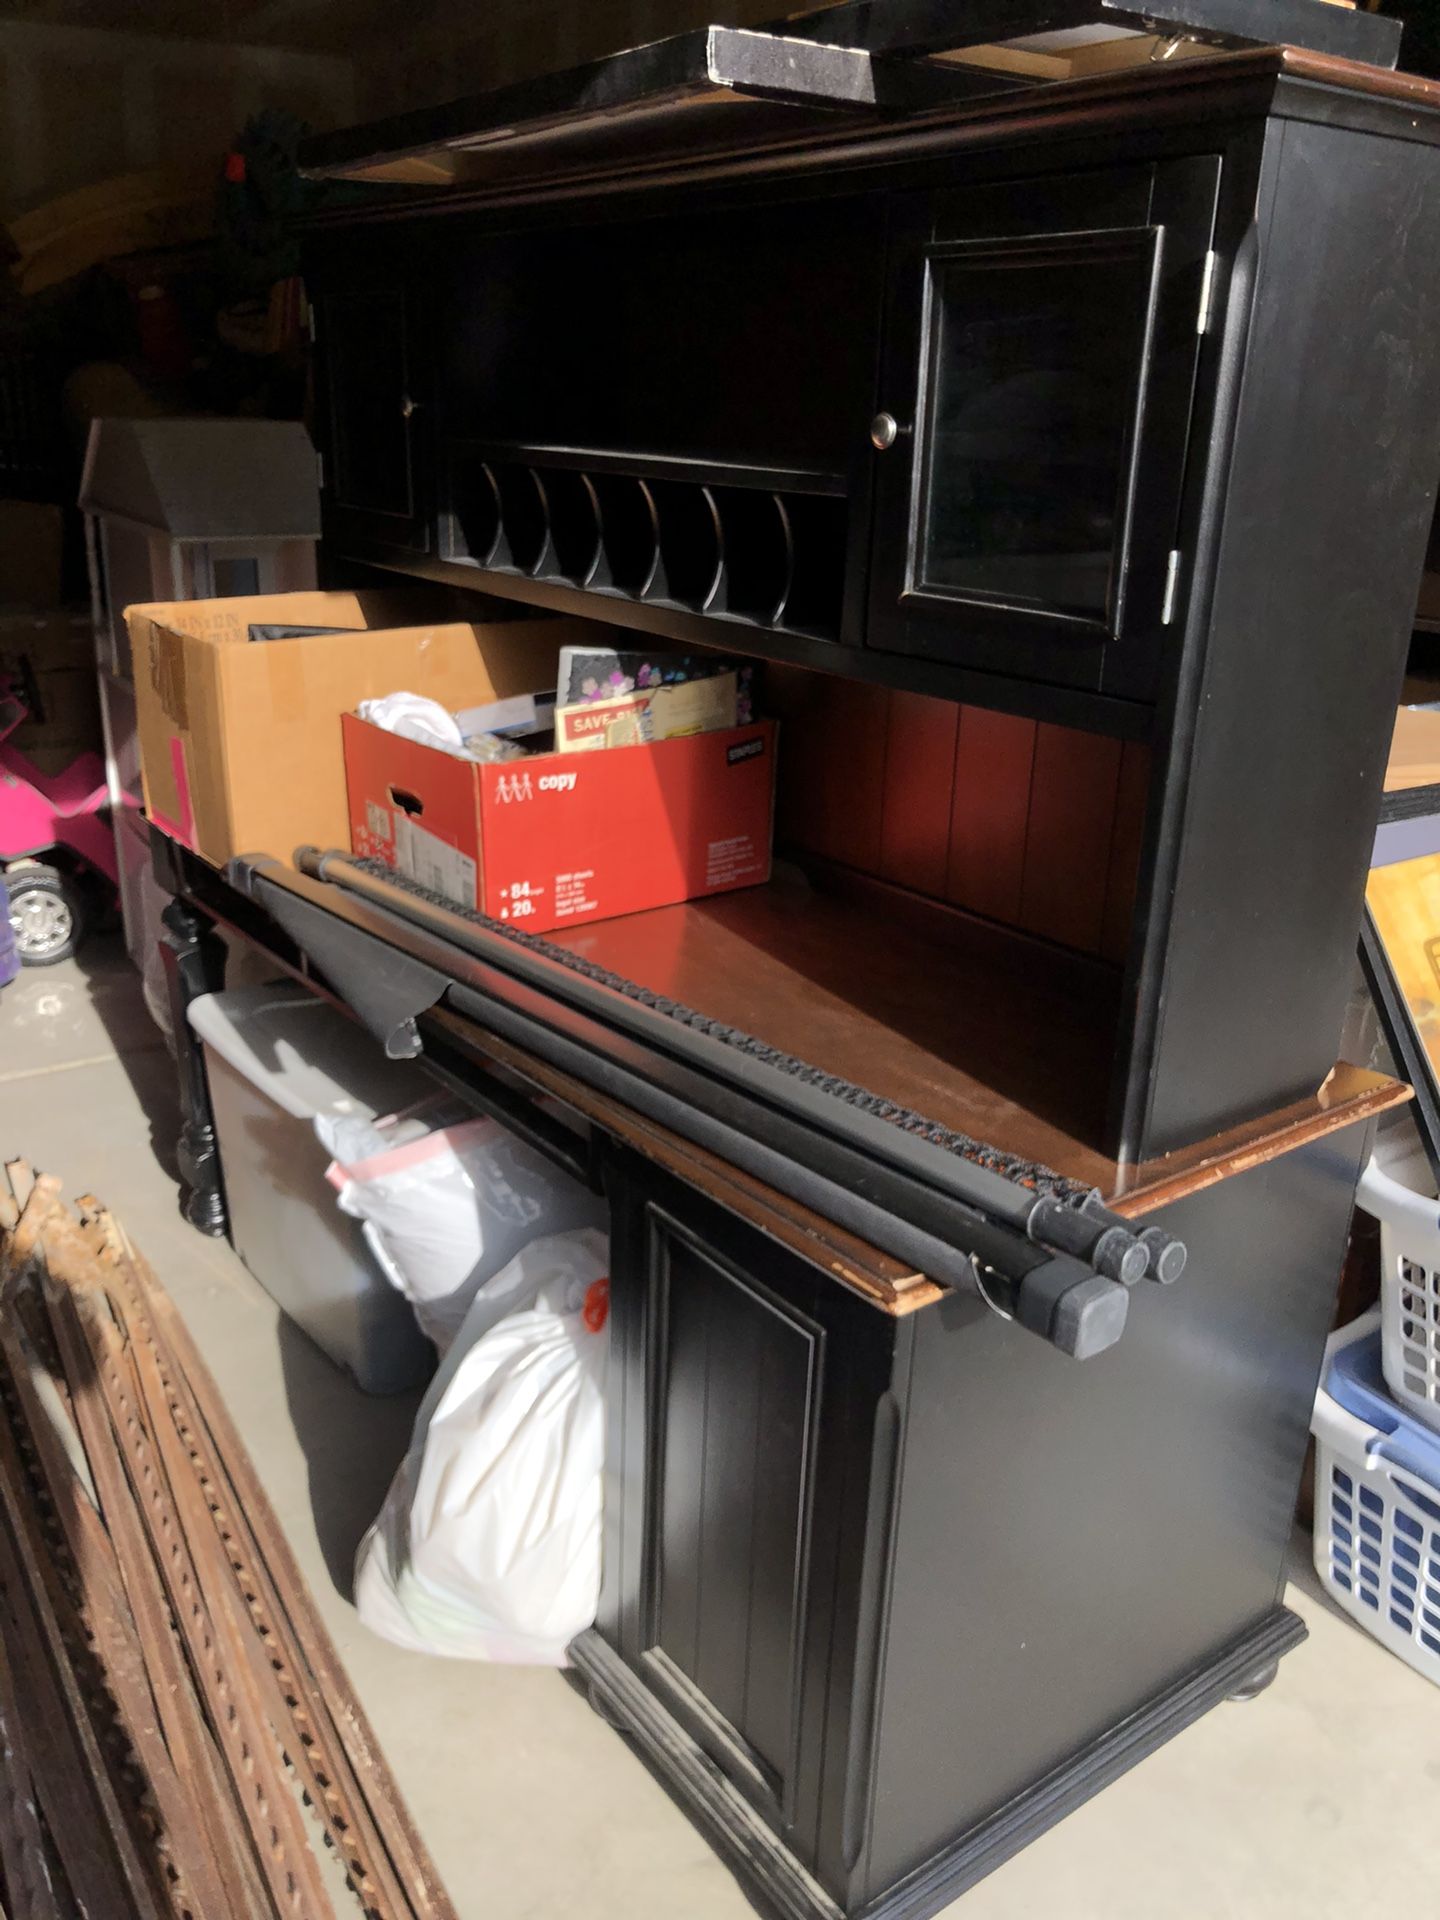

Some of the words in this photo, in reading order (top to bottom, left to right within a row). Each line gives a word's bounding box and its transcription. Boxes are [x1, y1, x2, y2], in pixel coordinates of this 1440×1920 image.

[573, 714, 611, 733] SAVE
[538, 772, 577, 793] copy
[510, 880, 530, 899] 84
[512, 897, 532, 918] 20
